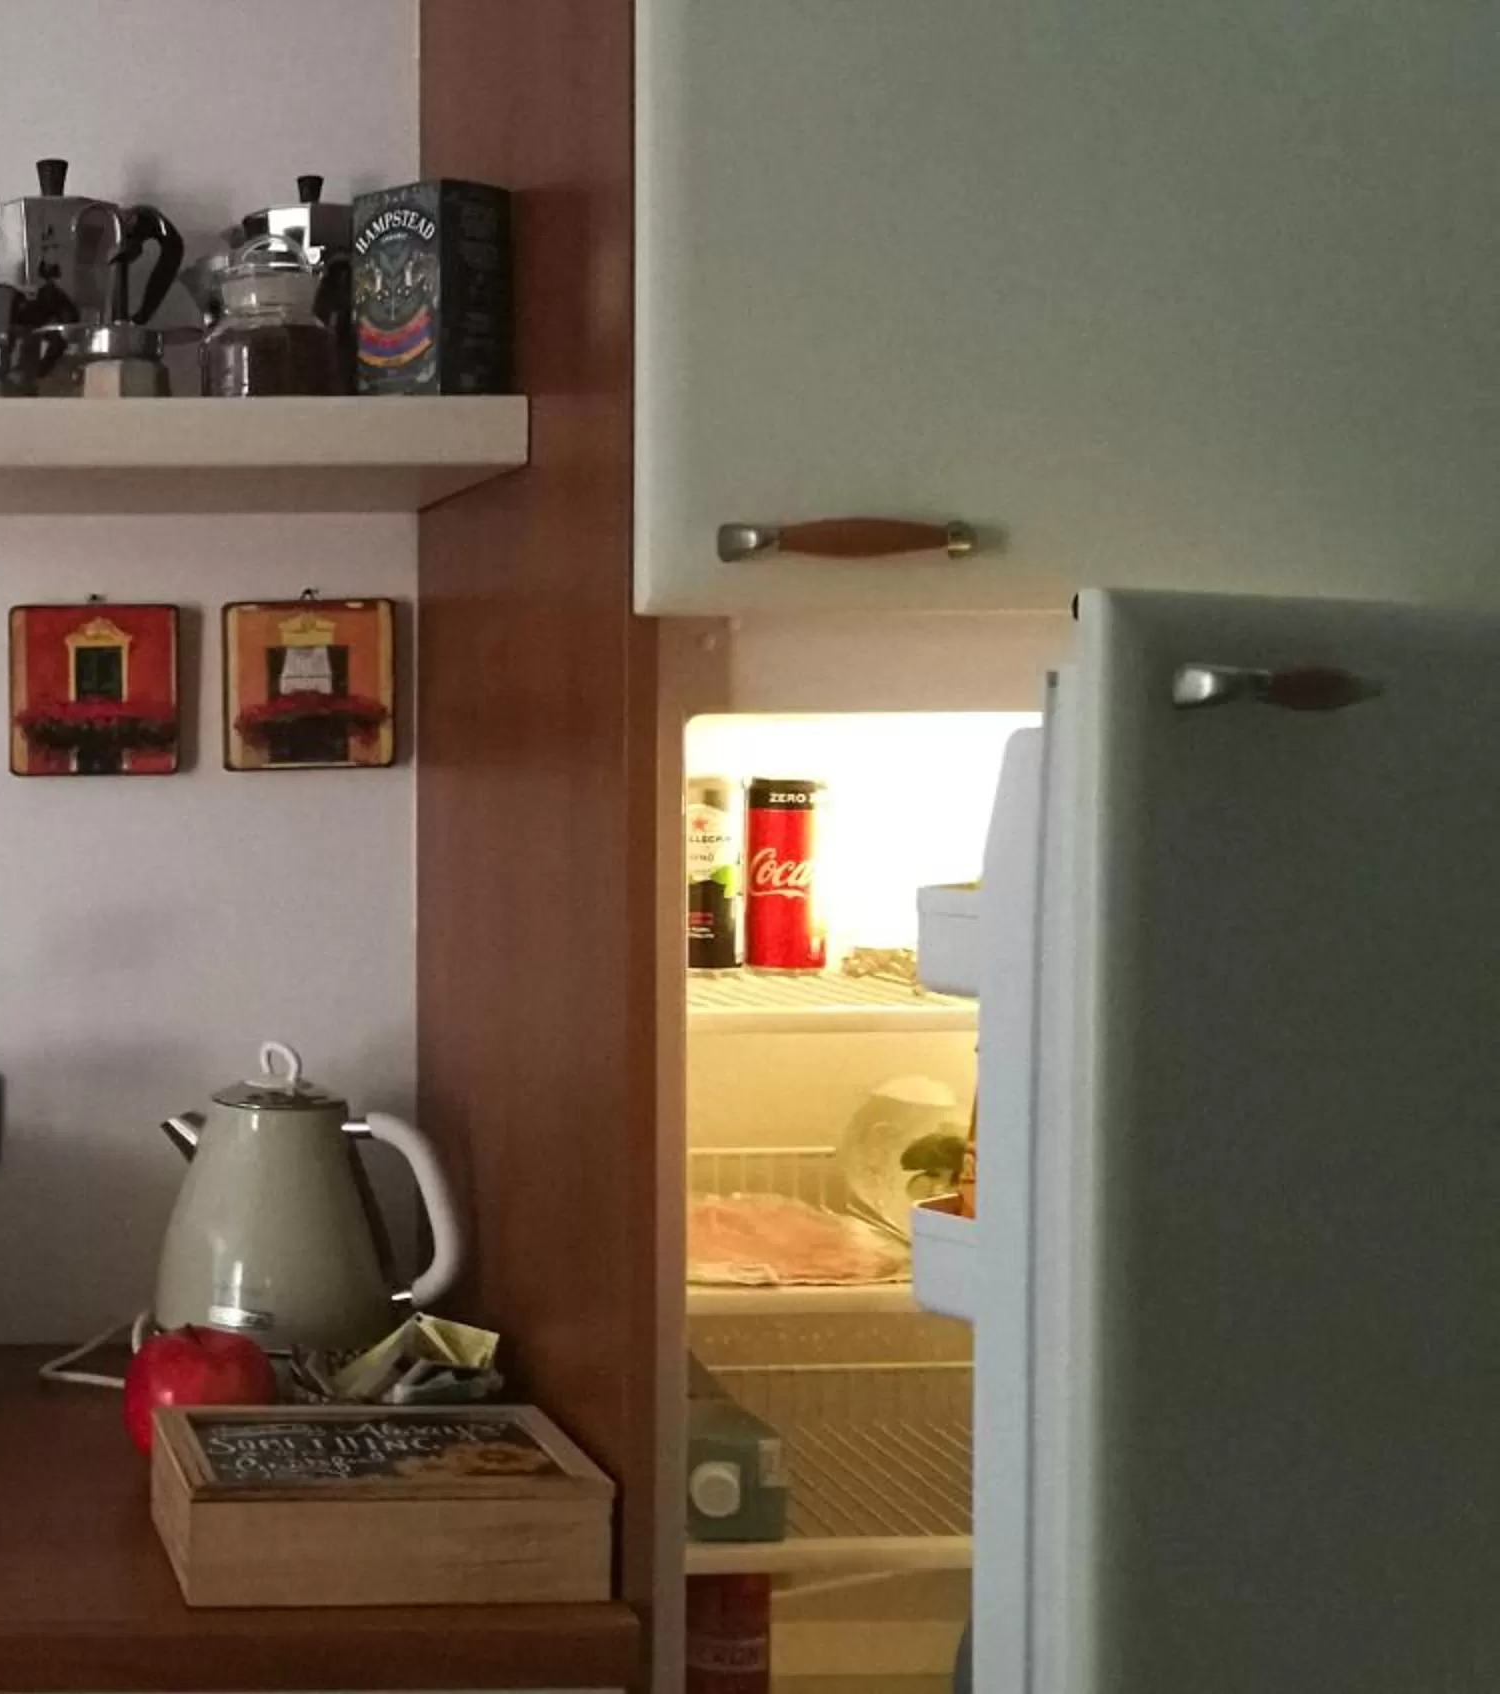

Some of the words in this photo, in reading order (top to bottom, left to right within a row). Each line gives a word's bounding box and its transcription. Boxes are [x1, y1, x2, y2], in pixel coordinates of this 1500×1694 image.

[355, 209, 435, 254] HAMPSTEAD
[769, 793, 807, 804] ZERO
[751, 847, 814, 887] Coca
